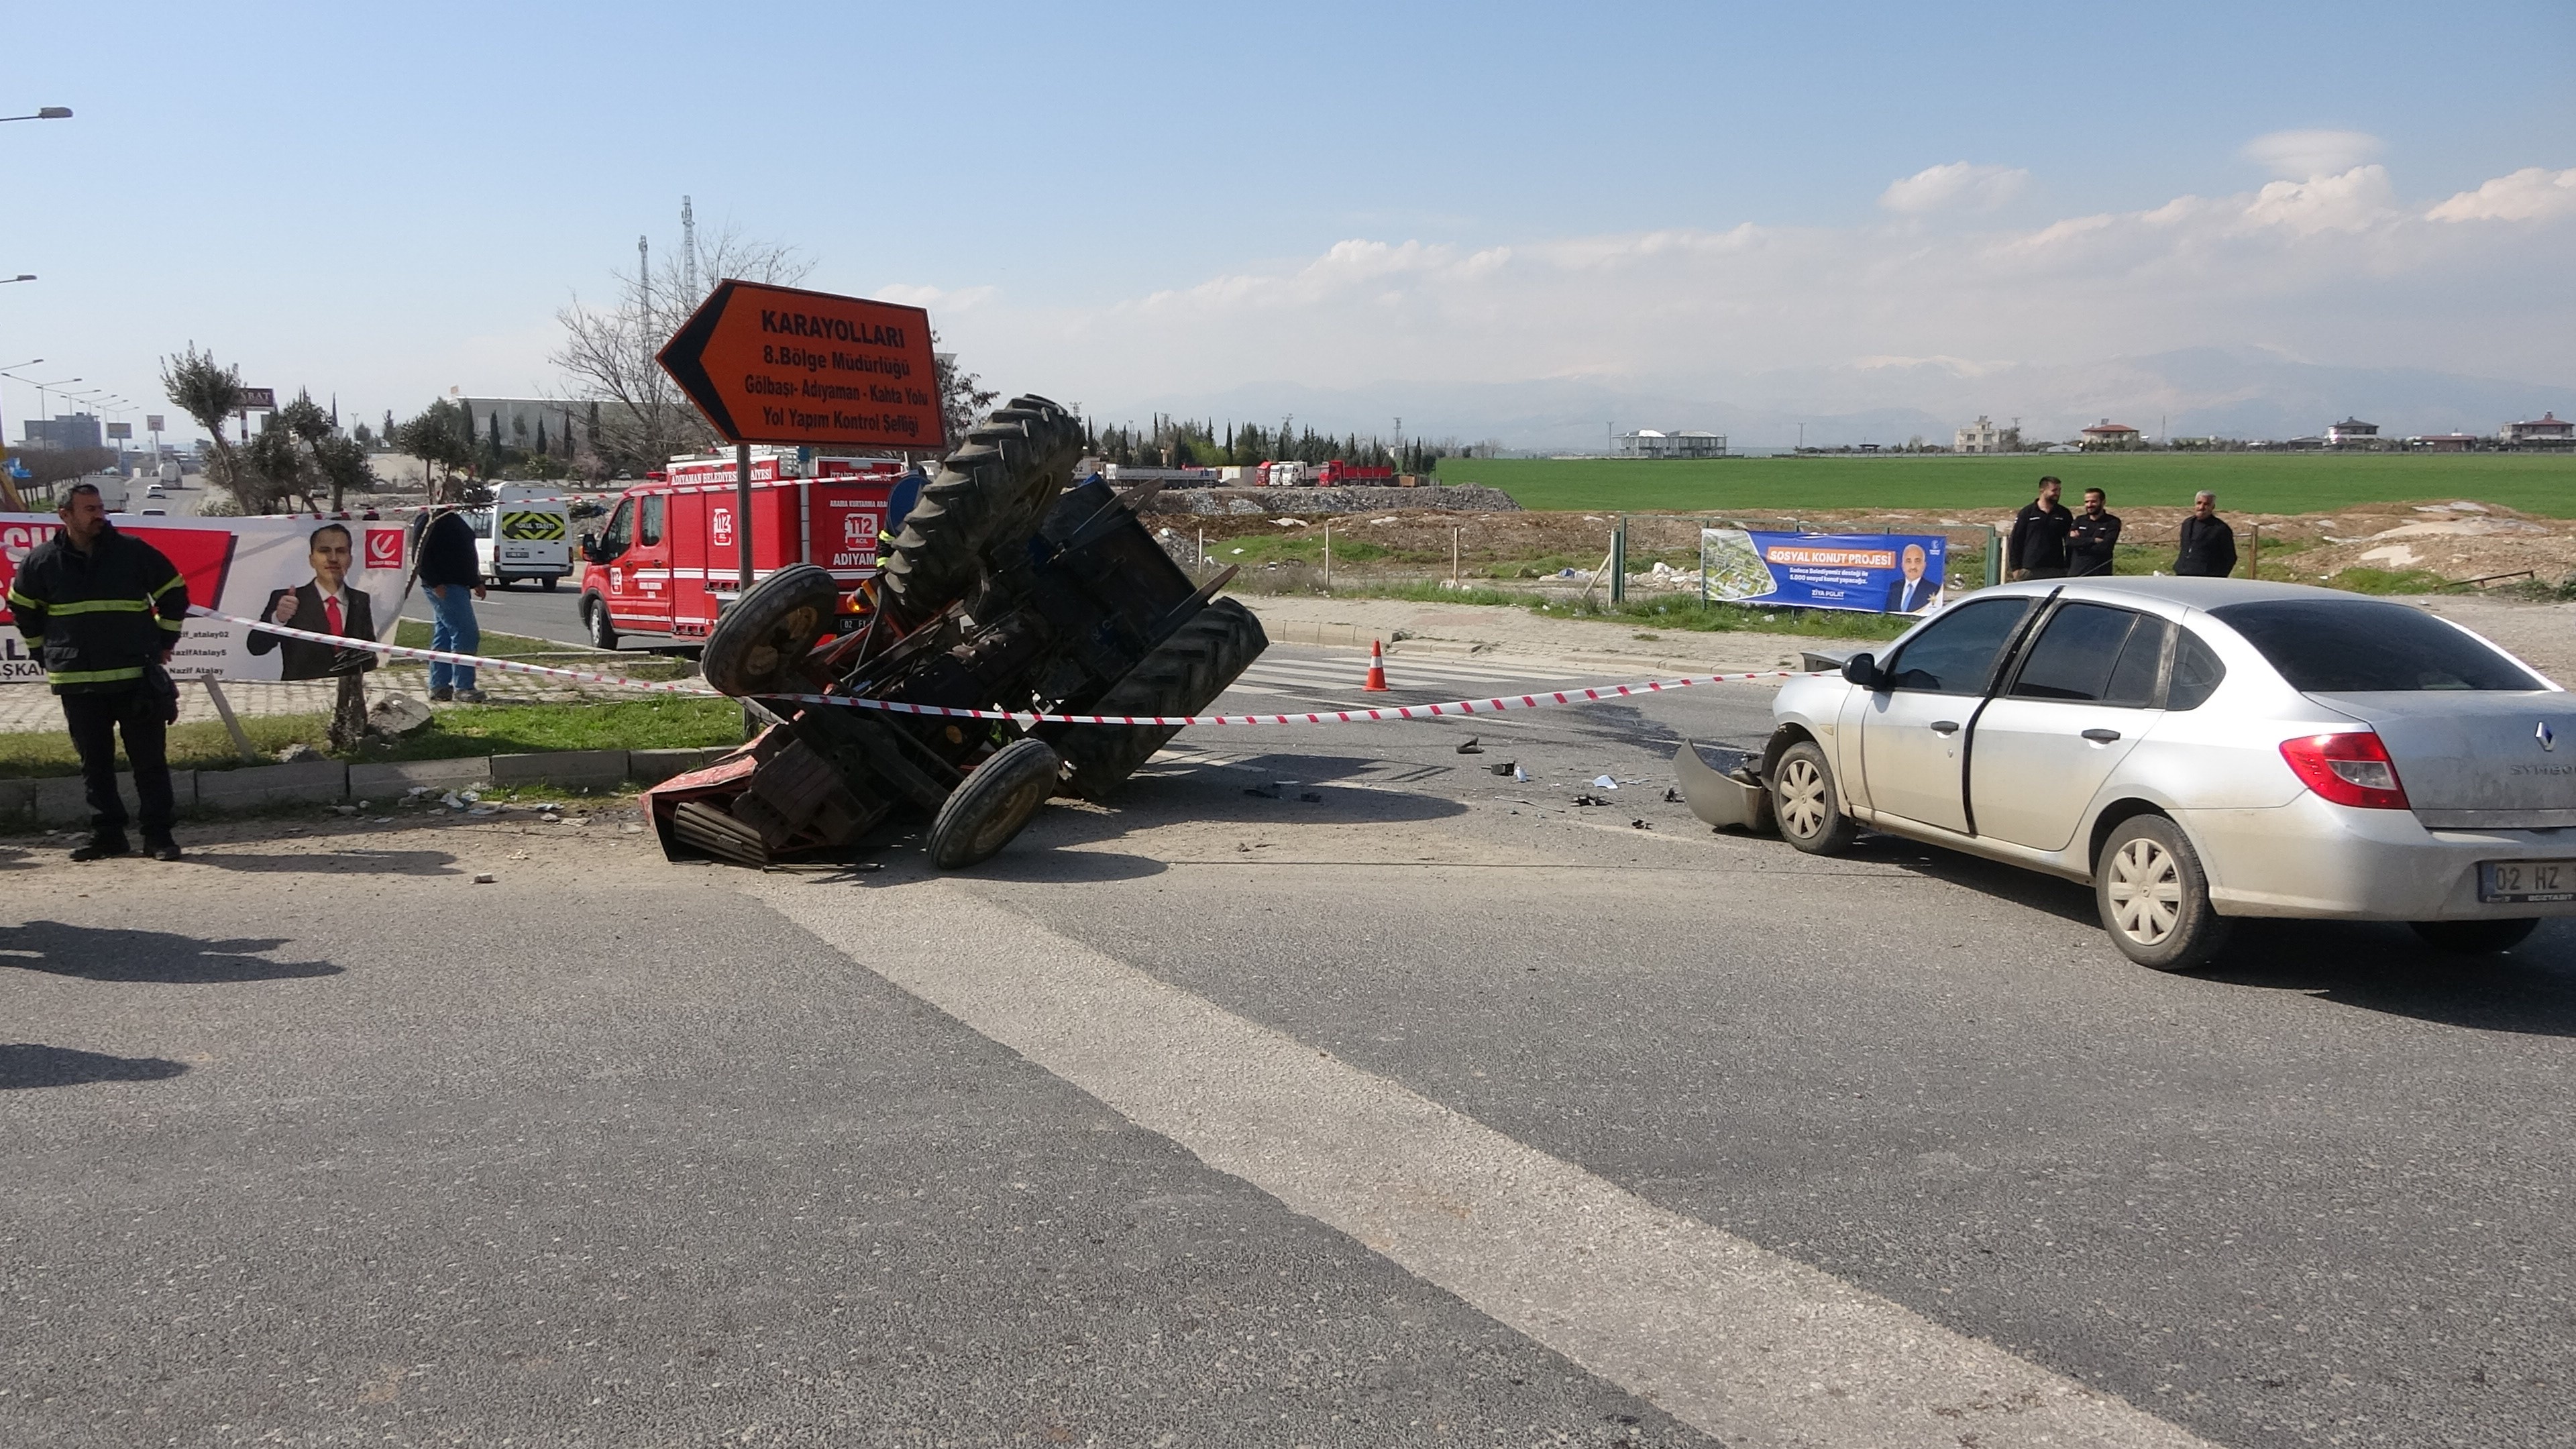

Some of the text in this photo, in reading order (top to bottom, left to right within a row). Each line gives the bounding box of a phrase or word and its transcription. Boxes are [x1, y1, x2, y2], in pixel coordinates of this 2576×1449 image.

[762, 309, 905, 348] KARAYOLLARI
[763, 345, 910, 380] 8.Bölge Müdürlüğü
[802, 378, 859, 402] Adıyaman
[869, 384, 903, 404] Kahta
[905, 387, 928, 406] Yolu
[763, 406, 919, 437] Yol Yapım Kontrol Şefliği
[672, 474, 702, 486] ADIYAMAN
[850, 517, 872, 534] 112
[833, 553, 876, 566] ADIYAM
[1770, 551, 1892, 565] SOSYAL KONUT PROJESİ
[2510, 765, 2576, 775] SYMBO
[2496, 865, 2559, 890] 02 HZ
